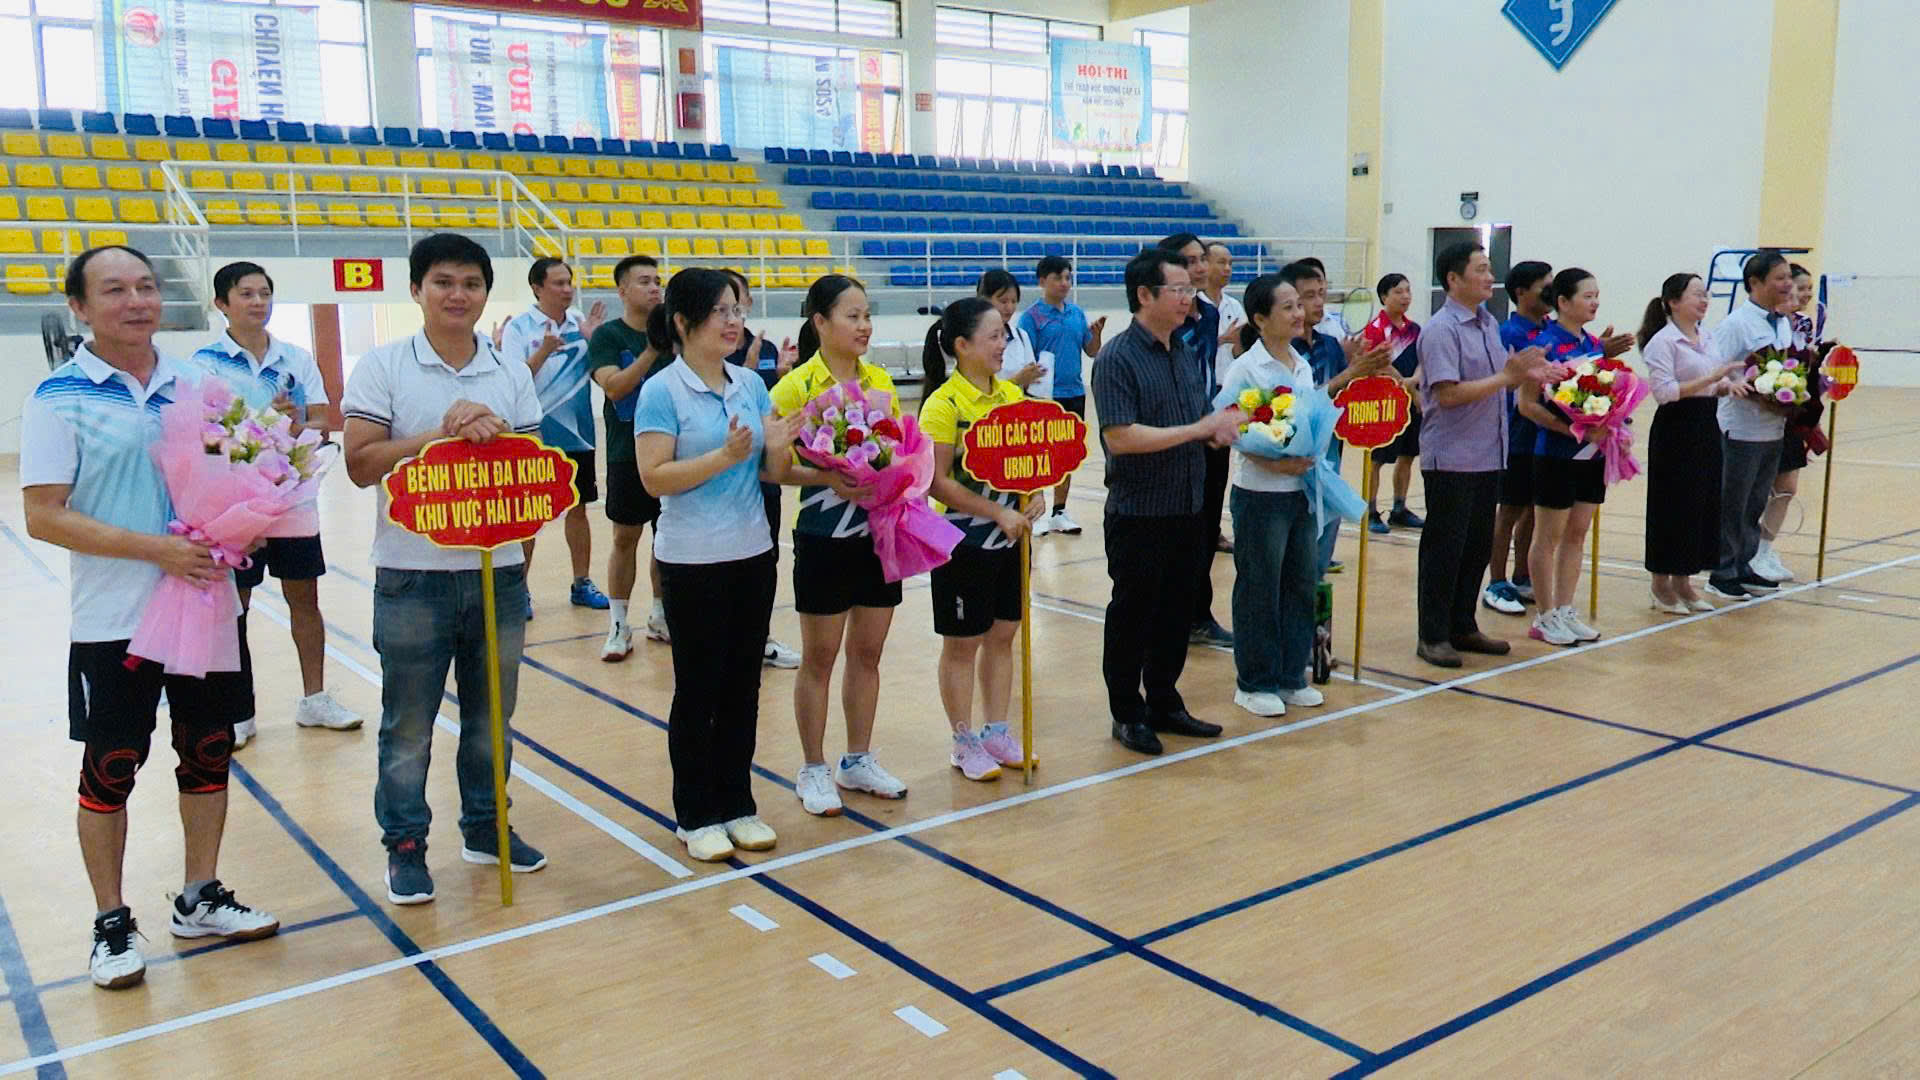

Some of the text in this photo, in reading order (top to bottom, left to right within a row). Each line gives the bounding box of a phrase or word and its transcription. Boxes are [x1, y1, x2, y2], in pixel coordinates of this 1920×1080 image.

[343, 262, 374, 288] B
[1347, 394, 1396, 429] TRỌNG TÀI
[976, 416, 1076, 448] KHỐI CÁC CƠ QUAN
[406, 456, 556, 499] BỆNH VIỆN ĐA KHOA
[1003, 450, 1052, 480] UBND XÃ
[415, 489, 554, 534] KHU VỰC HẢI LĂNG
